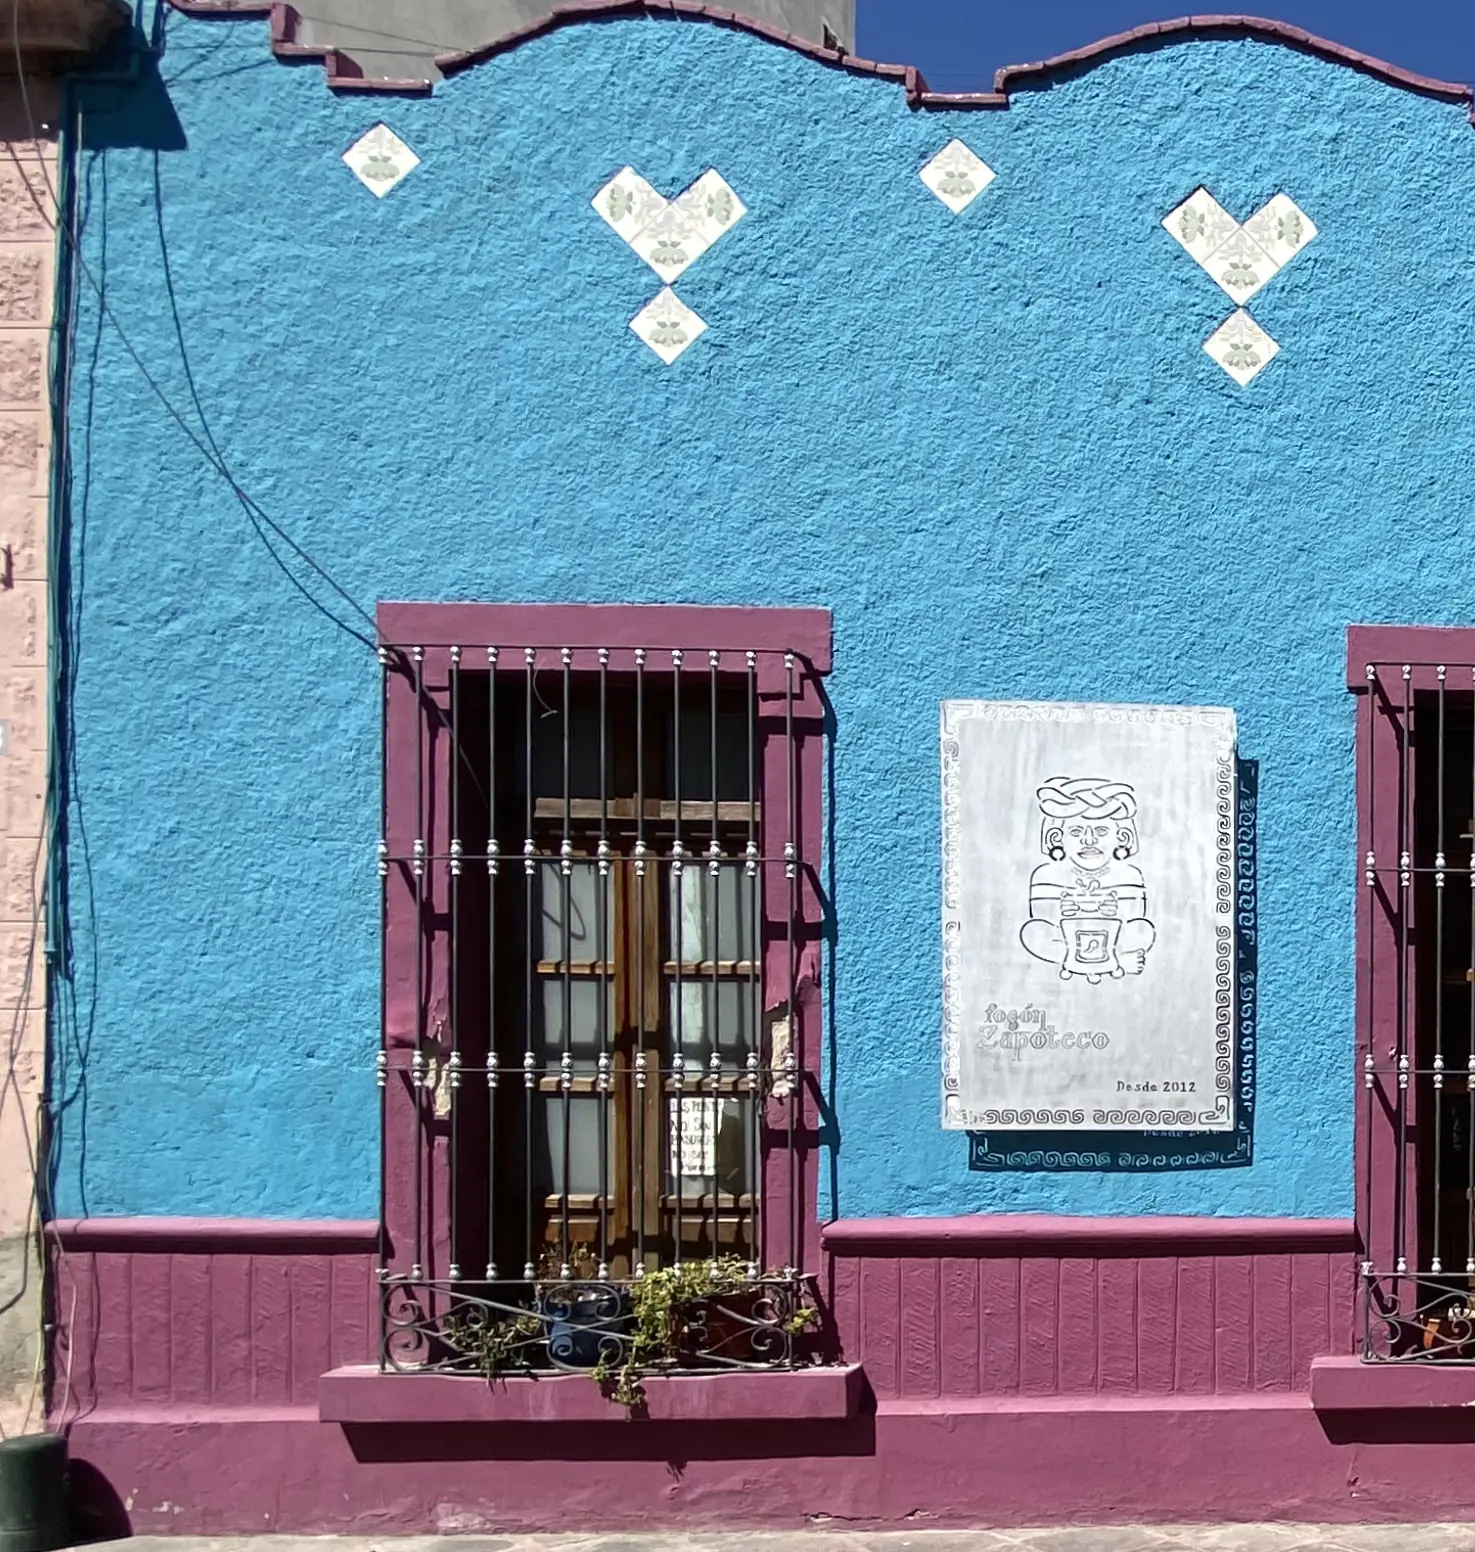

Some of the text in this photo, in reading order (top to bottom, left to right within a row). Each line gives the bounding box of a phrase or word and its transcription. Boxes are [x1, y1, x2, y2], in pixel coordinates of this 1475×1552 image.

[984, 1003, 1047, 1031] fogón
[976, 1024, 1110, 1061] Zapoteco
[1116, 1080, 1196, 1092] Desde 2012
